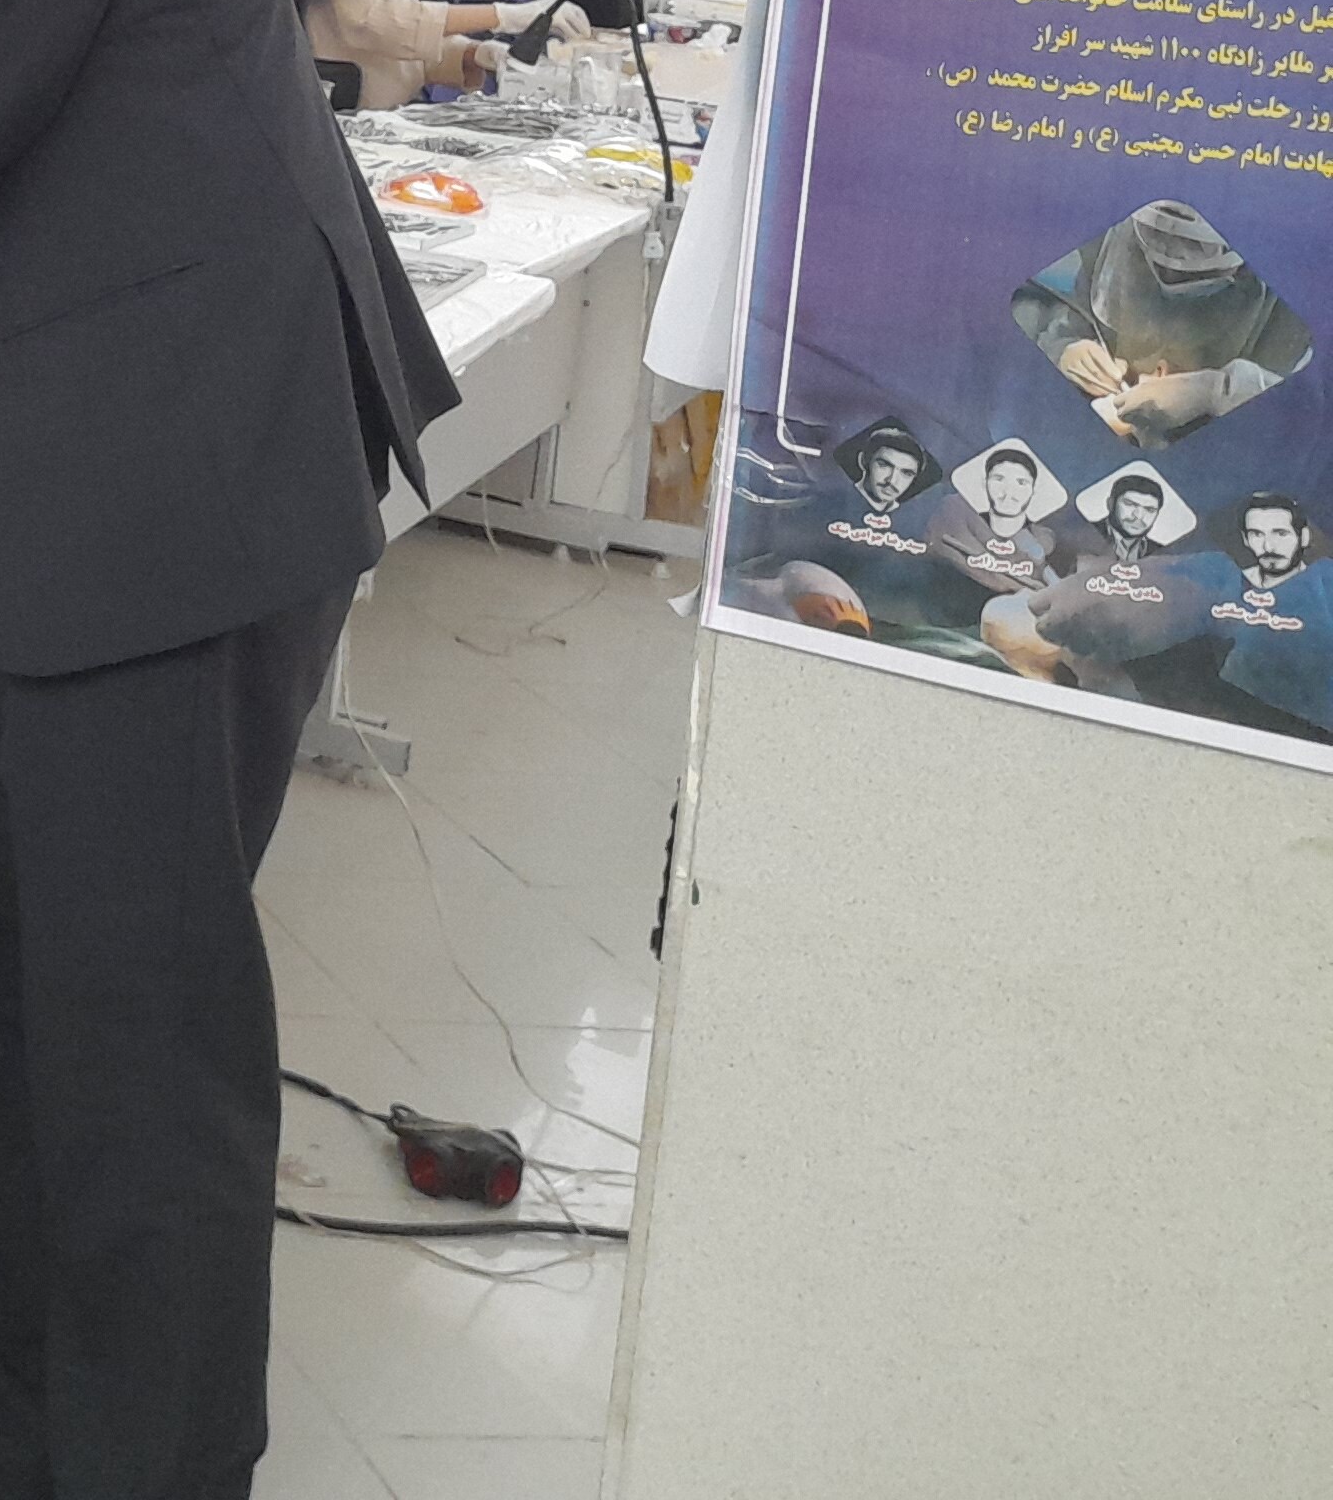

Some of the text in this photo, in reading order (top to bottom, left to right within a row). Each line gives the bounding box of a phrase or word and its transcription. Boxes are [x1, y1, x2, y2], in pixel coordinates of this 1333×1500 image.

[1269, 7, 1295, 30] در
[1111, 35, 1154, 59] شهید
[1161, 35, 1200, 60] ۱۱۰۰
[1207, 44, 1264, 75] زادگاه
[1267, 50, 1313, 77] ملایر
[988, 69, 1036, 90] محمد
[1041, 74, 1101, 100] حضرت
[1105, 79, 1154, 104] اسلام
[1157, 87, 1203, 114] مکرم
[1208, 92, 1242, 119] نبی
[1247, 96, 1301, 128] رحلت
[991, 110, 1022, 140] رضا
[1028, 116, 1065, 142] امام
[1124, 133, 1183, 158] مجتبی
[1188, 143, 1235, 163] حسن
[1240, 143, 1280, 169] امام
